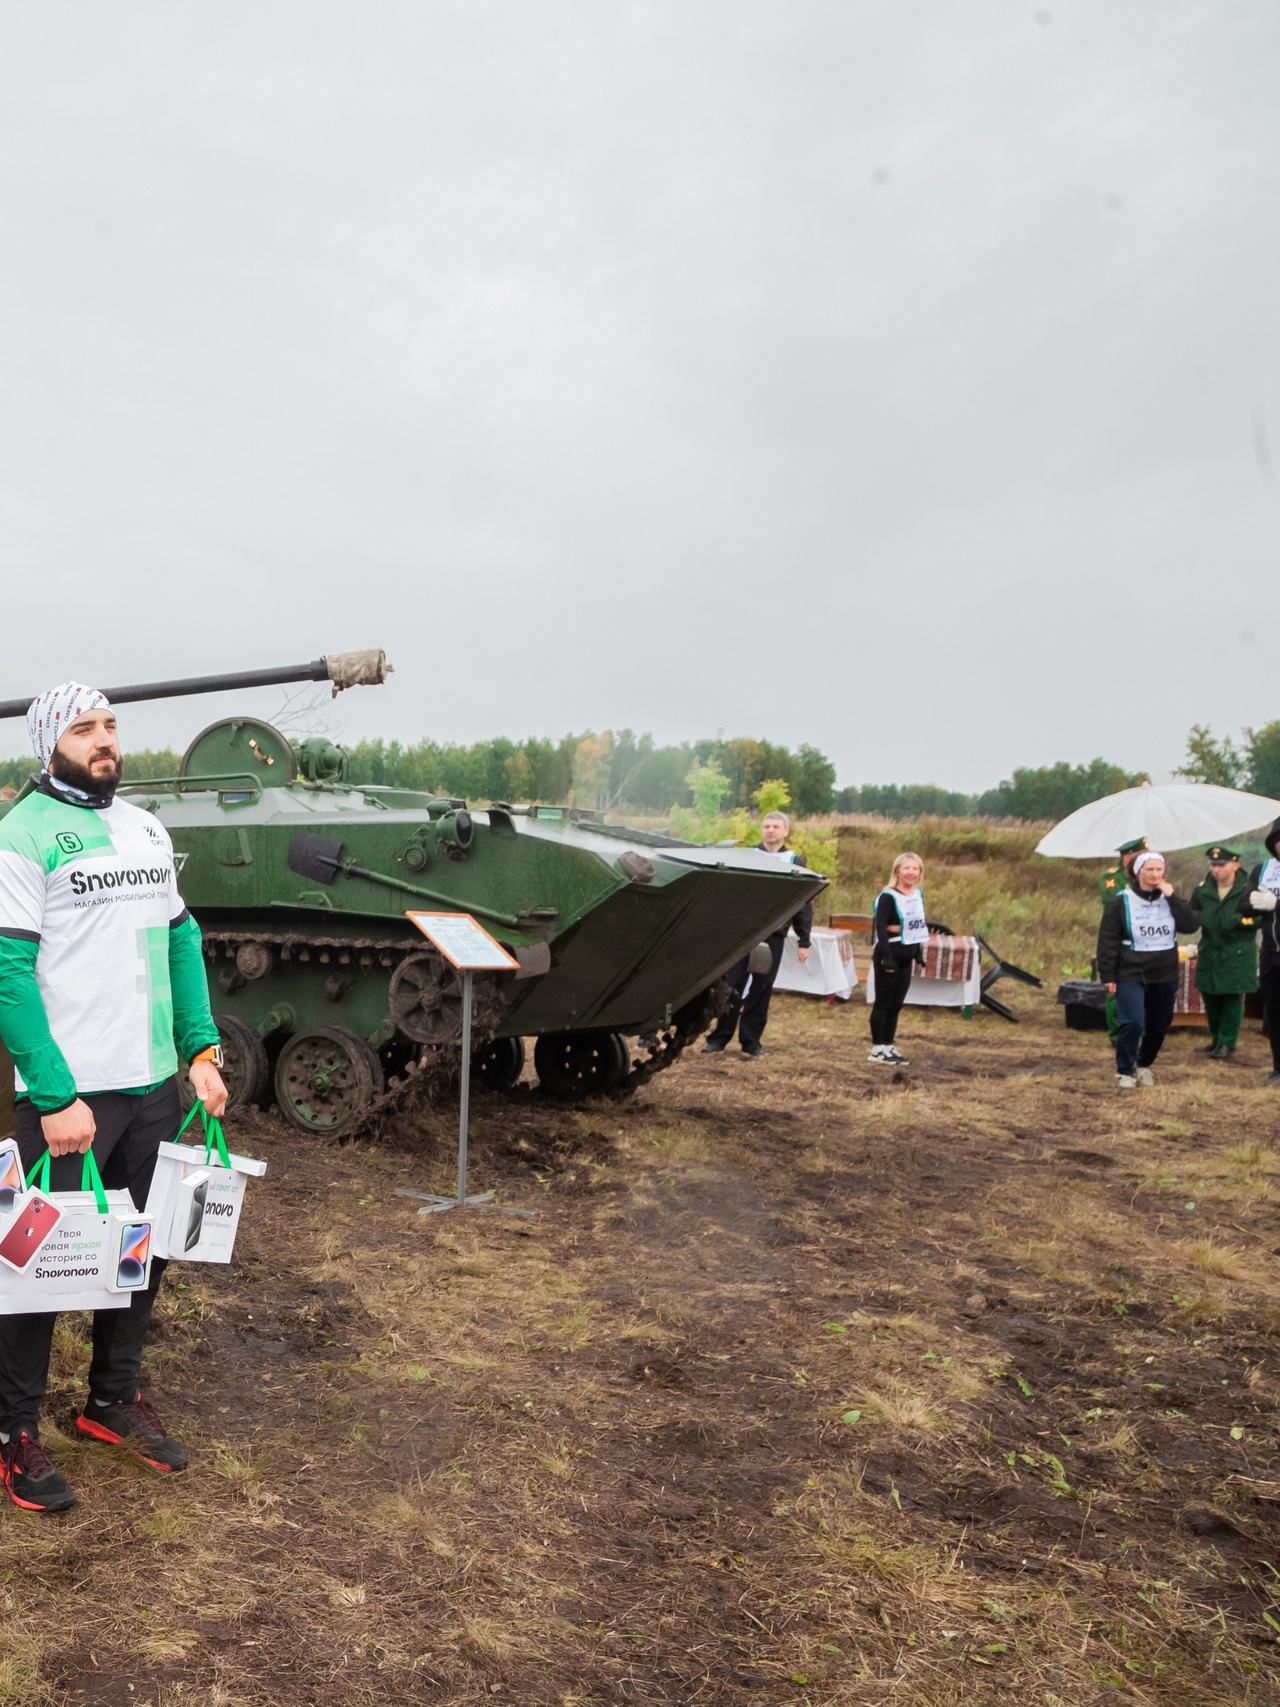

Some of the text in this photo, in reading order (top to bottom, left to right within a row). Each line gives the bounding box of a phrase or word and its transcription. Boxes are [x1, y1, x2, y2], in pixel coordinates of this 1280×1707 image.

[74, 898, 114, 909] МАГАЗИН
[115, 890, 156, 903] МОБИЛЬНОЙ
[58, 1230, 81, 1238] Твоя
[71, 1241, 102, 1252] яркая
[40, 1254, 82, 1264] история
[35, 1267, 99, 1279] Snovonovo
